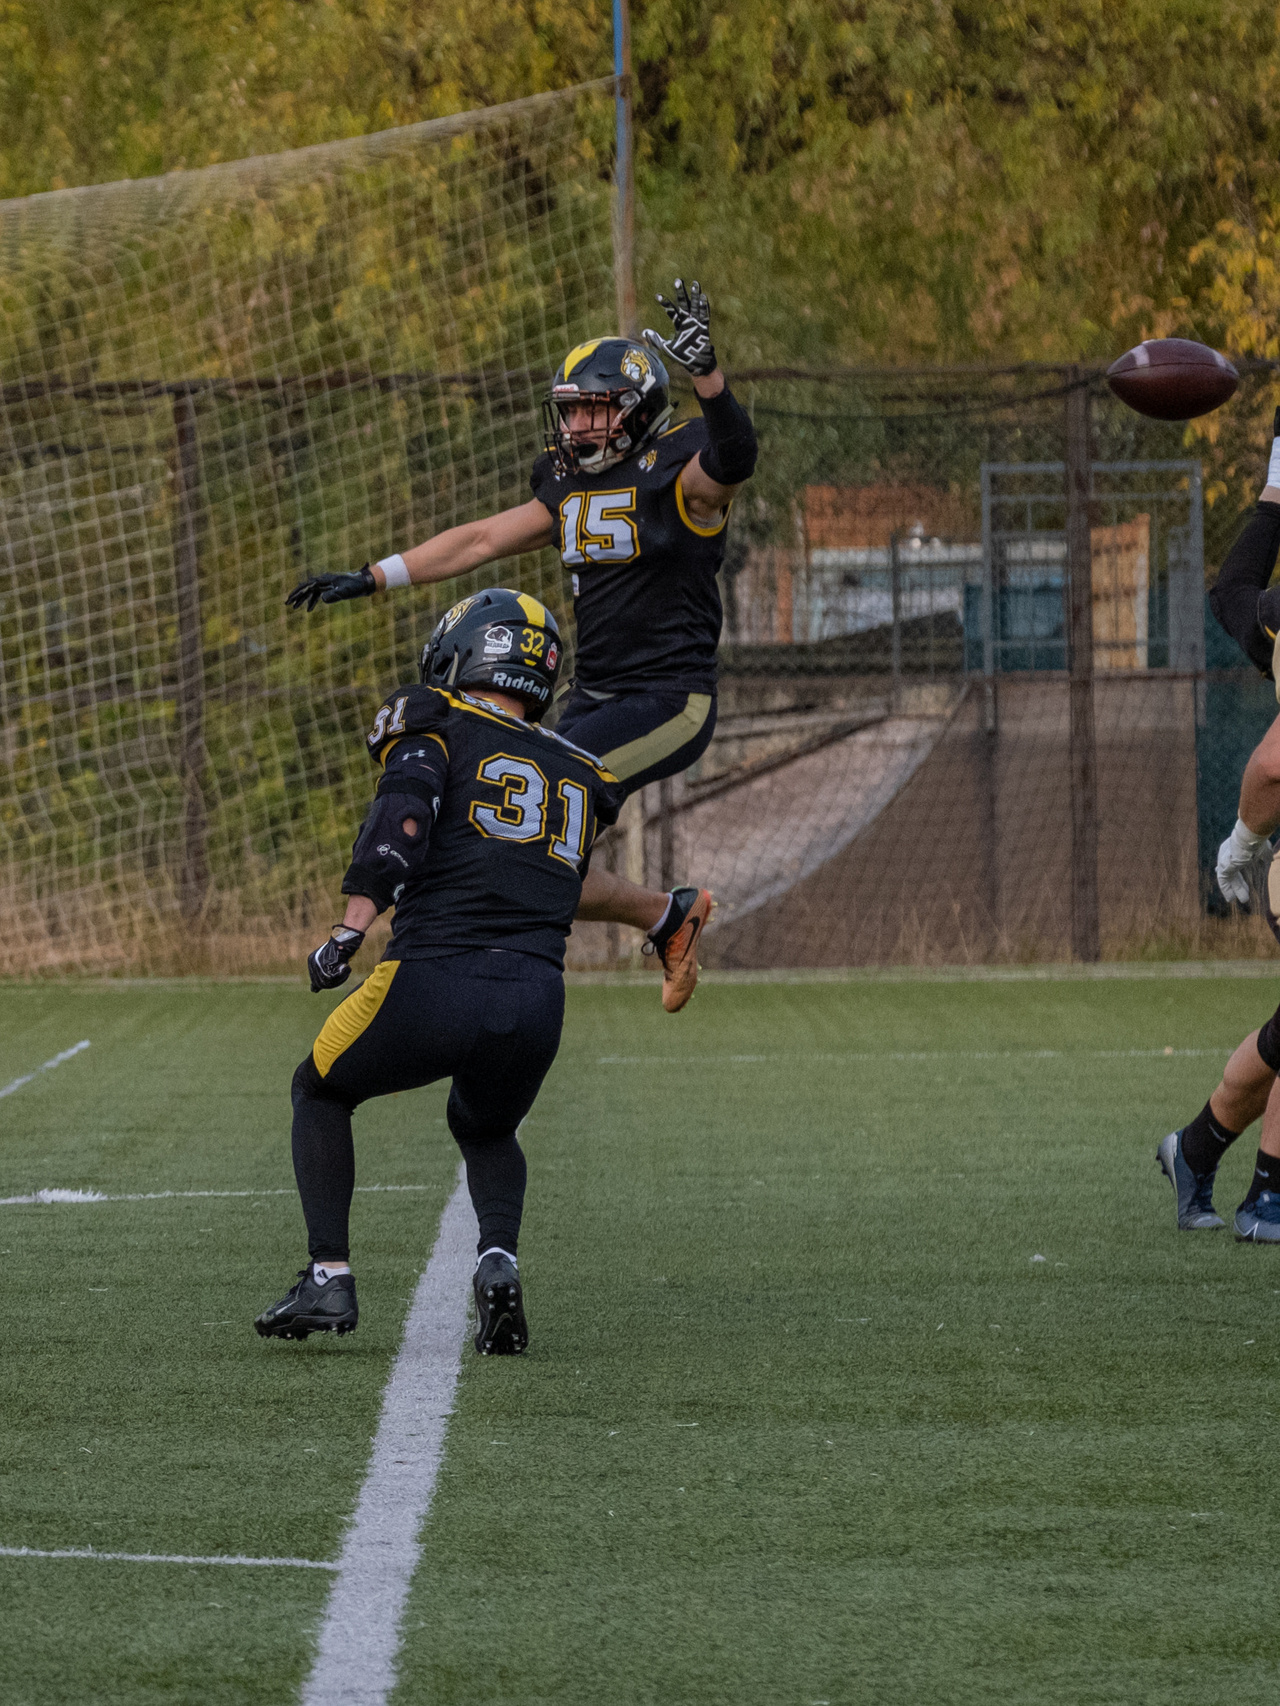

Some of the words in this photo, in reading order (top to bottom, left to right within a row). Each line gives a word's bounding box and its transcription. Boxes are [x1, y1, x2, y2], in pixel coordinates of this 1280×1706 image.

[559, 486, 641, 567] 15
[520, 628, 545, 658] 32
[492, 671, 549, 702] Riddell
[367, 696, 409, 746] 31
[468, 752, 588, 873] 31
